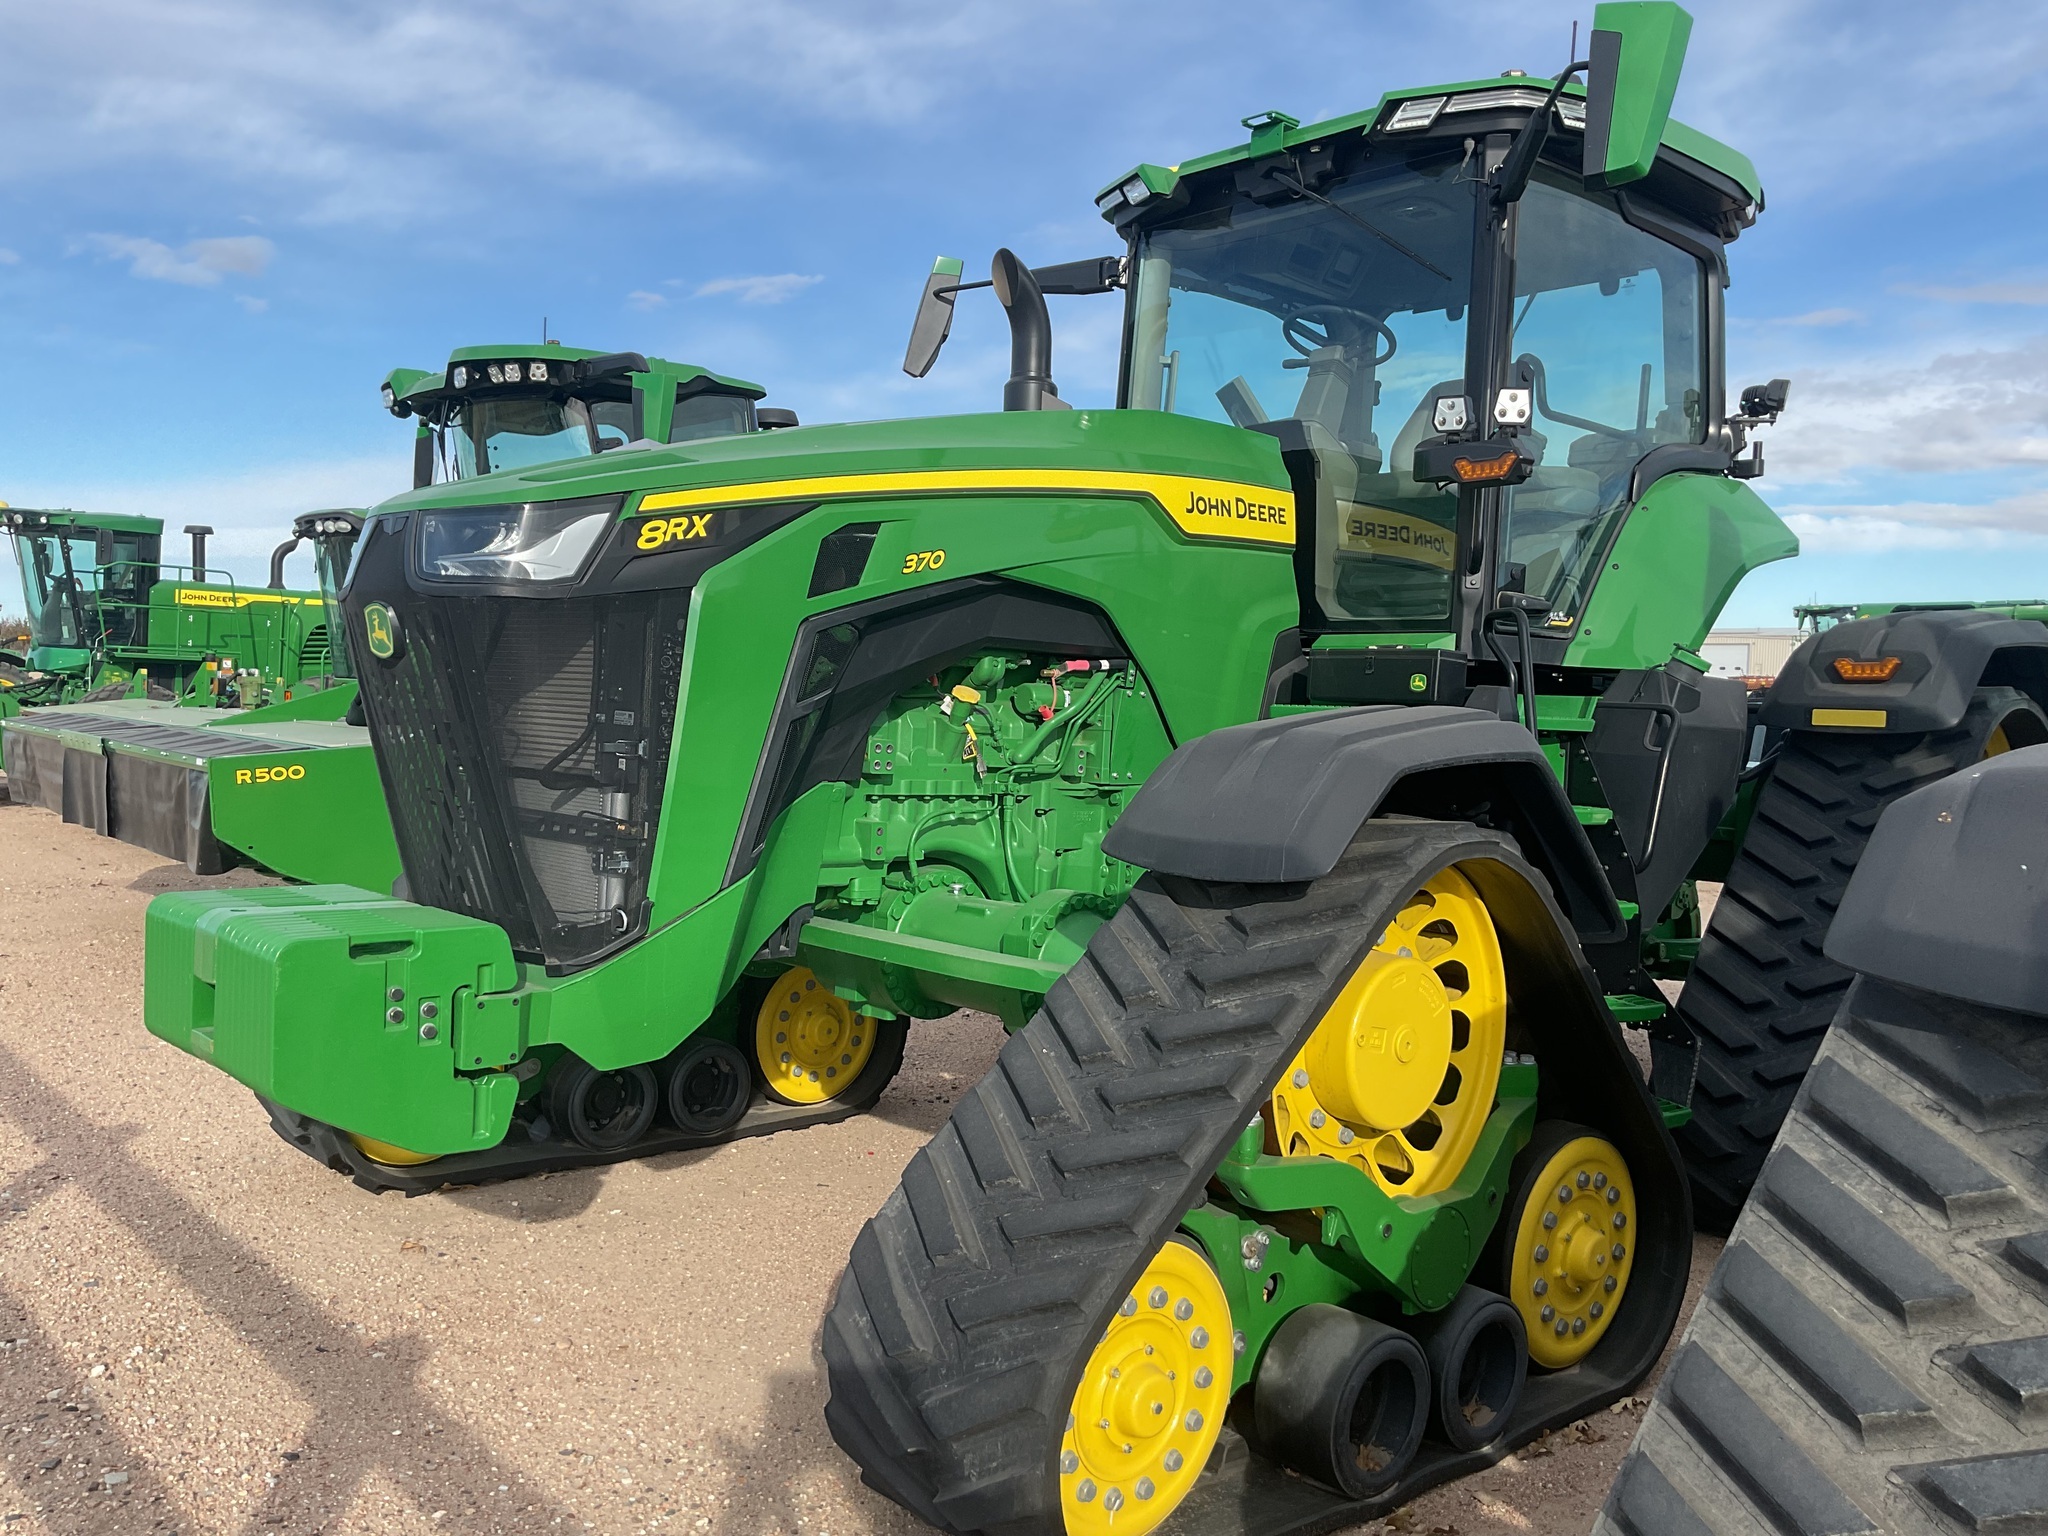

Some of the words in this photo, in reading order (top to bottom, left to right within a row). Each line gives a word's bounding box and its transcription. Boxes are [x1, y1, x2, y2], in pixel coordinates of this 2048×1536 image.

[1186, 491, 1232, 518] JOHN
[1235, 496, 1286, 525] DEERE
[637, 513, 713, 549] 8RX
[902, 549, 946, 574] 370
[182, 592, 207, 601] JOHN
[235, 764, 306, 785] R500
